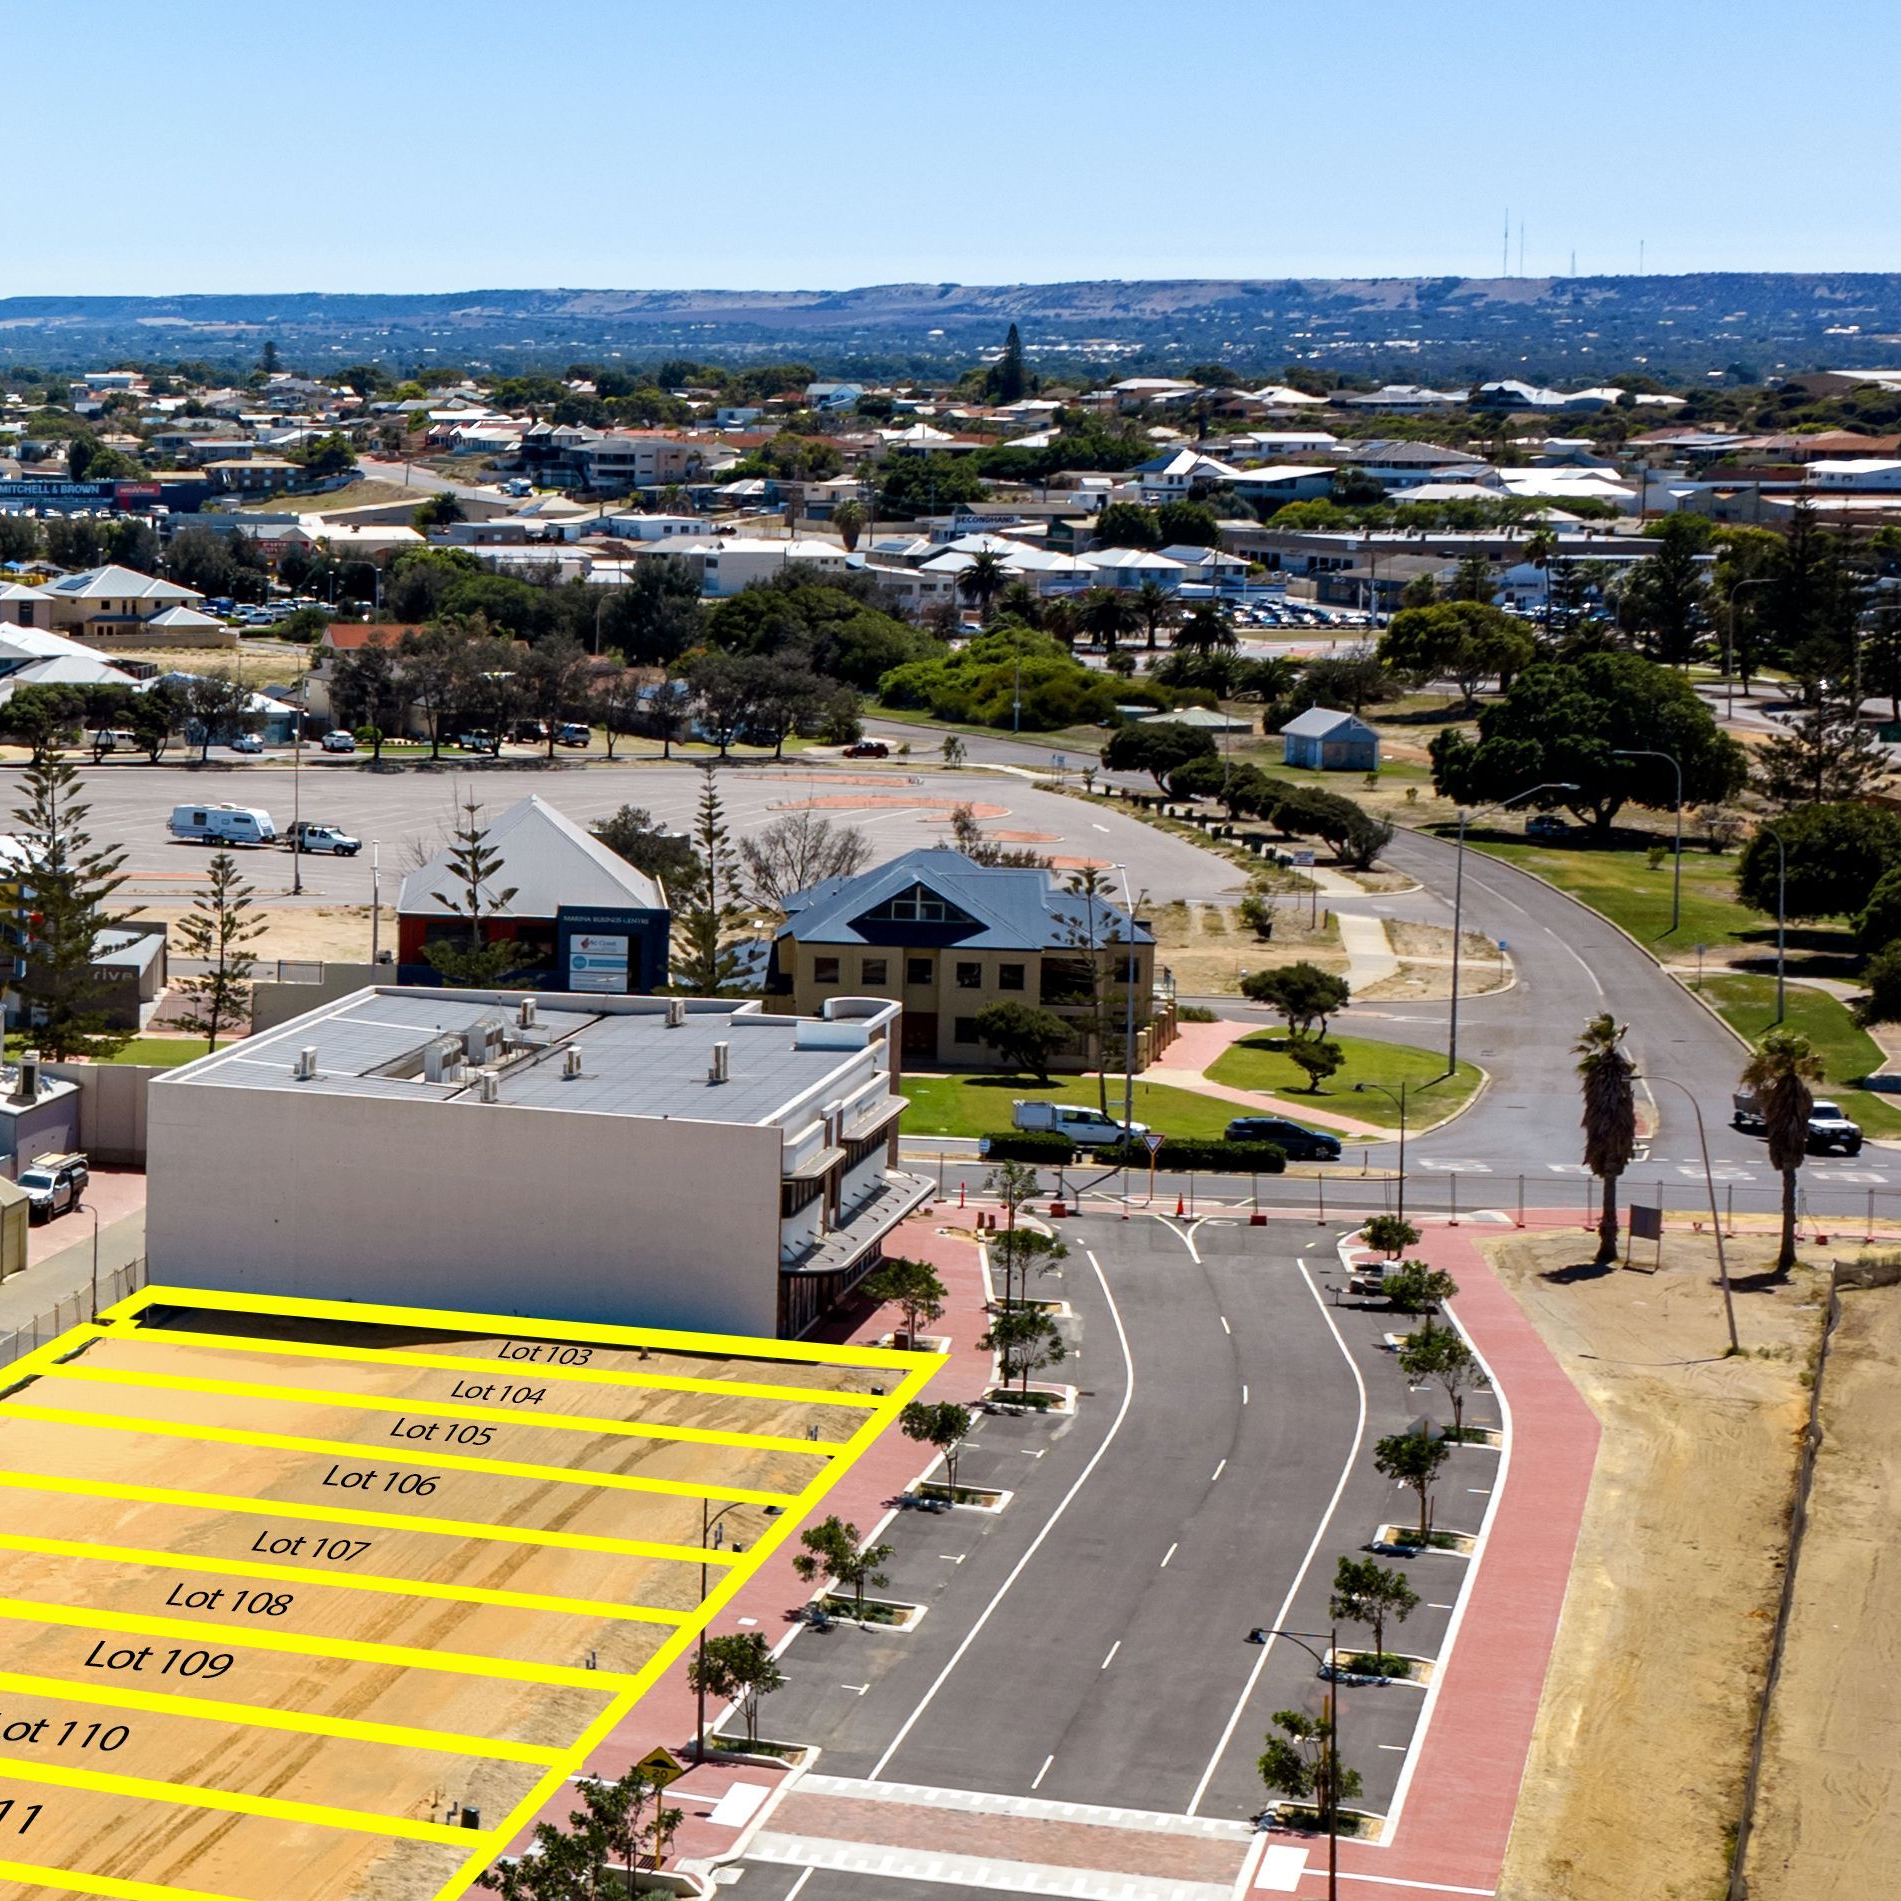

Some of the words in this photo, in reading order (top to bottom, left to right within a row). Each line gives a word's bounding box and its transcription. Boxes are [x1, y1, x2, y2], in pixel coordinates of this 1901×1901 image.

[563, 915, 591, 923] MARINA
[623, 916, 649, 925] CENTRE
[652, 1769, 668, 1780] 20
